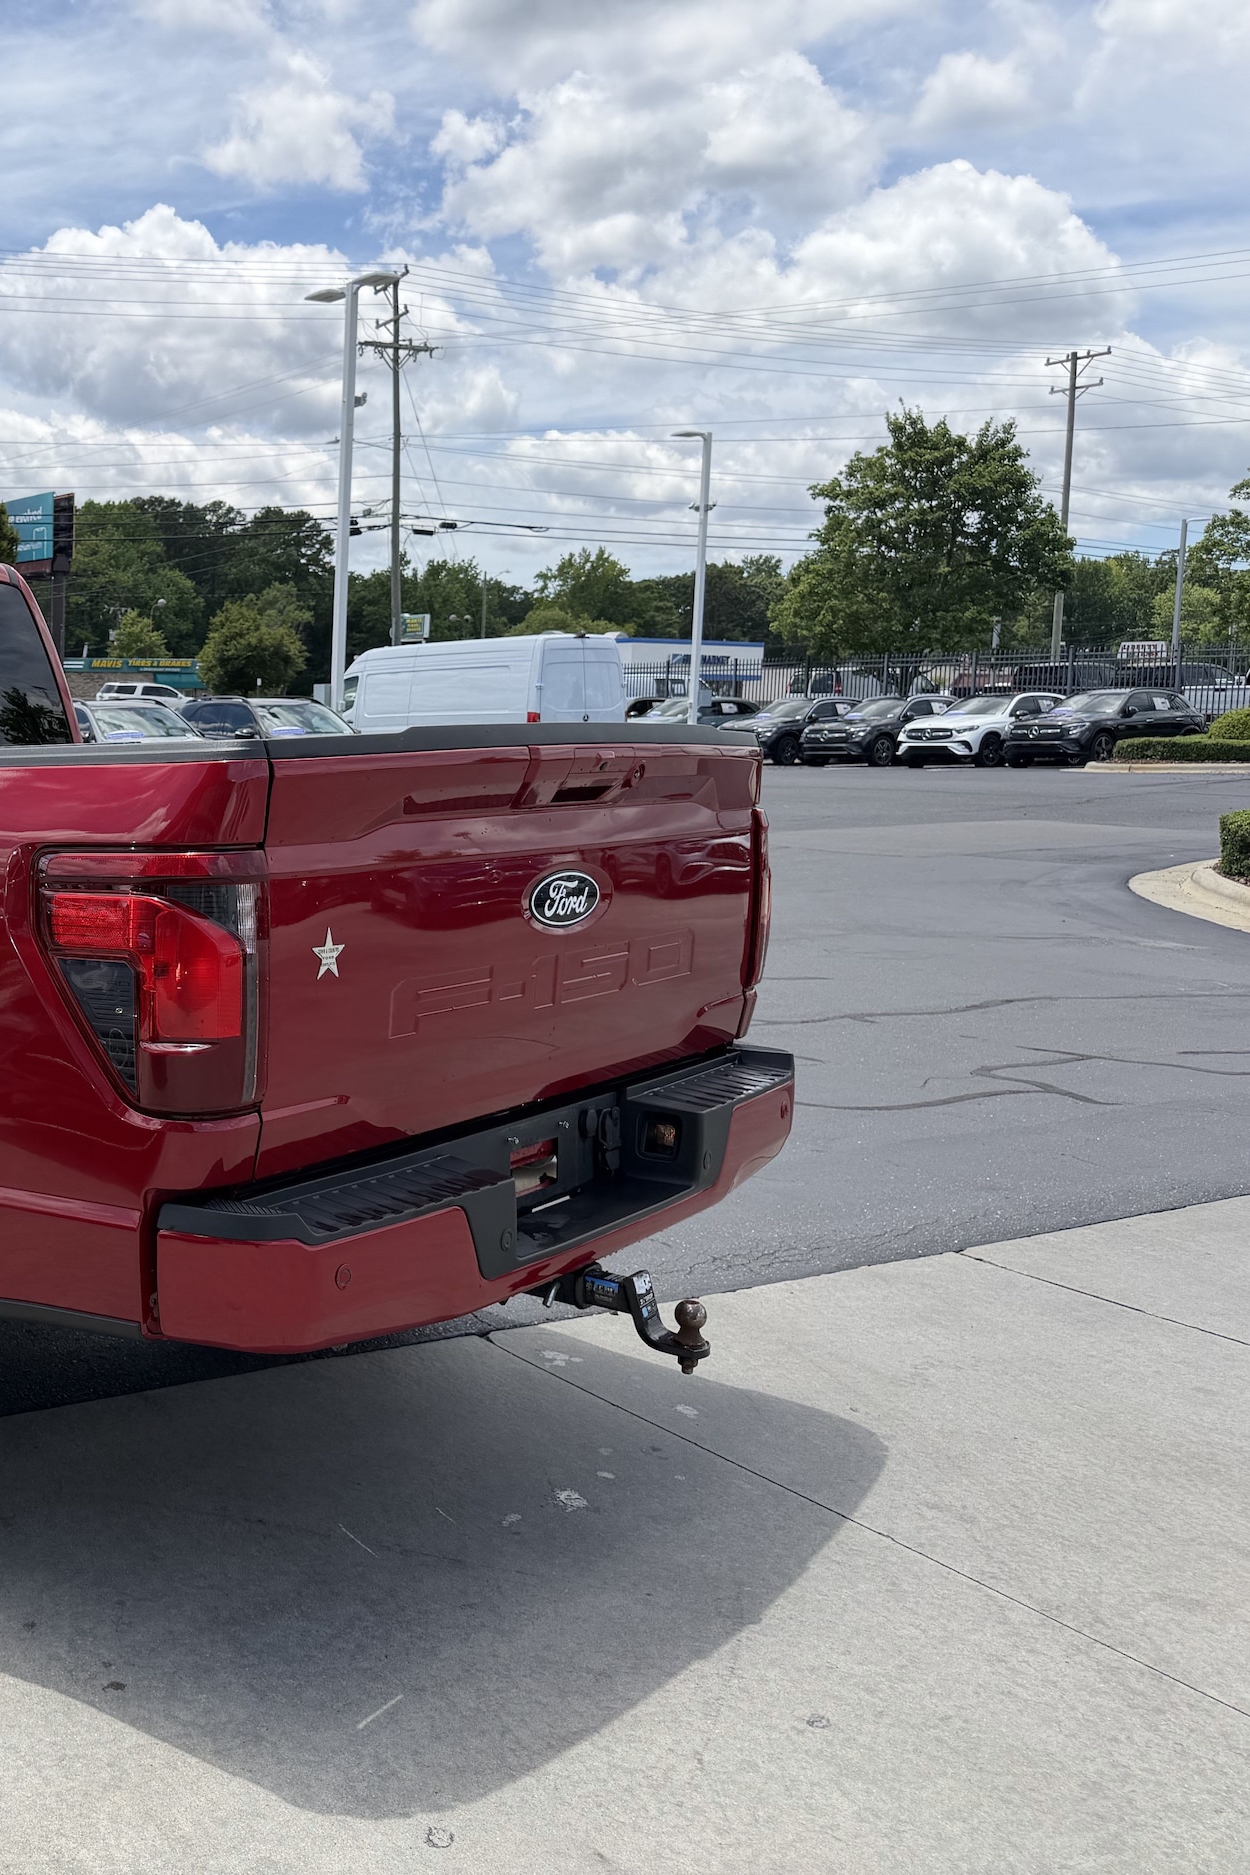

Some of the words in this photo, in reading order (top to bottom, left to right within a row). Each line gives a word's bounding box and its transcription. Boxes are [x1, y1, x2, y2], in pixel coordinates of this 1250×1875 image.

[92, 660, 123, 668] MAVIS
[543, 880, 588, 917] Ford
[388, 928, 695, 1039] F-150
